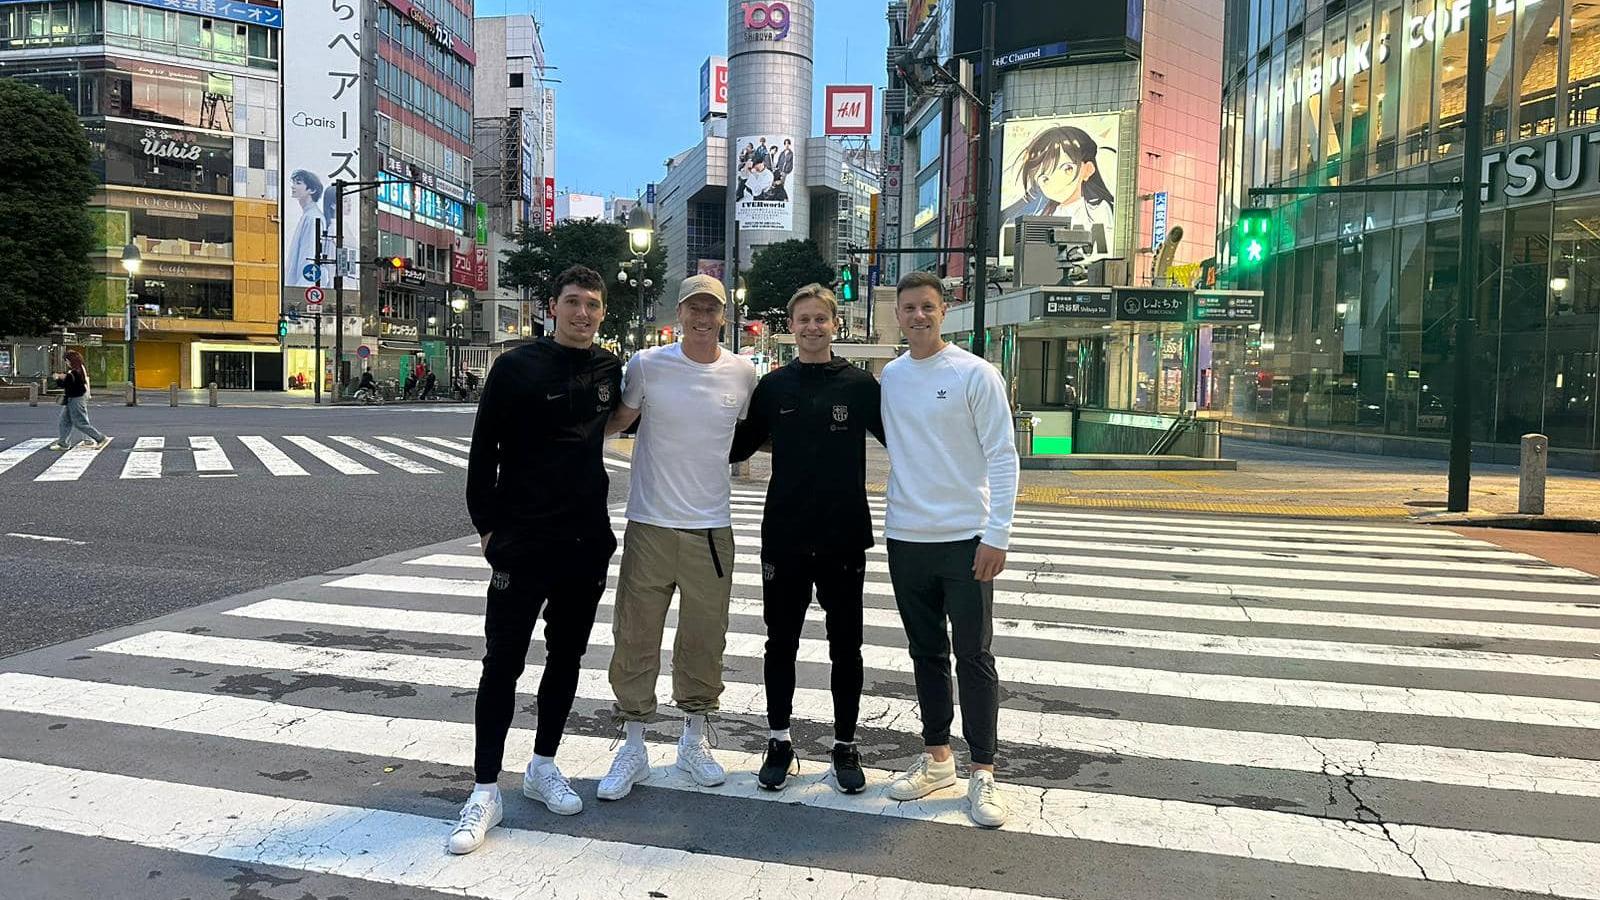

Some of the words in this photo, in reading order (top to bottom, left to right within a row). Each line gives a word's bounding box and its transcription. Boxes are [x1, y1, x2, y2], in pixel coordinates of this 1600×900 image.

[741, 2, 790, 42] 109
[743, 31, 773, 42] SHIBUYA
[1009, 48, 1040, 63] Channel
[837, 102, 861, 118] H&M
[305, 117, 336, 129] pairs
[140, 137, 201, 160] Ushi8
[1480, 132, 1600, 201] TSU
[136, 197, 208, 211] L'OCCITANE
[455, 255, 471, 271] アコム
[1058, 304, 1079, 312] 渋谷駅
[1080, 305, 1098, 313] Shibuya
[1143, 298, 1182, 308] しぶちか
